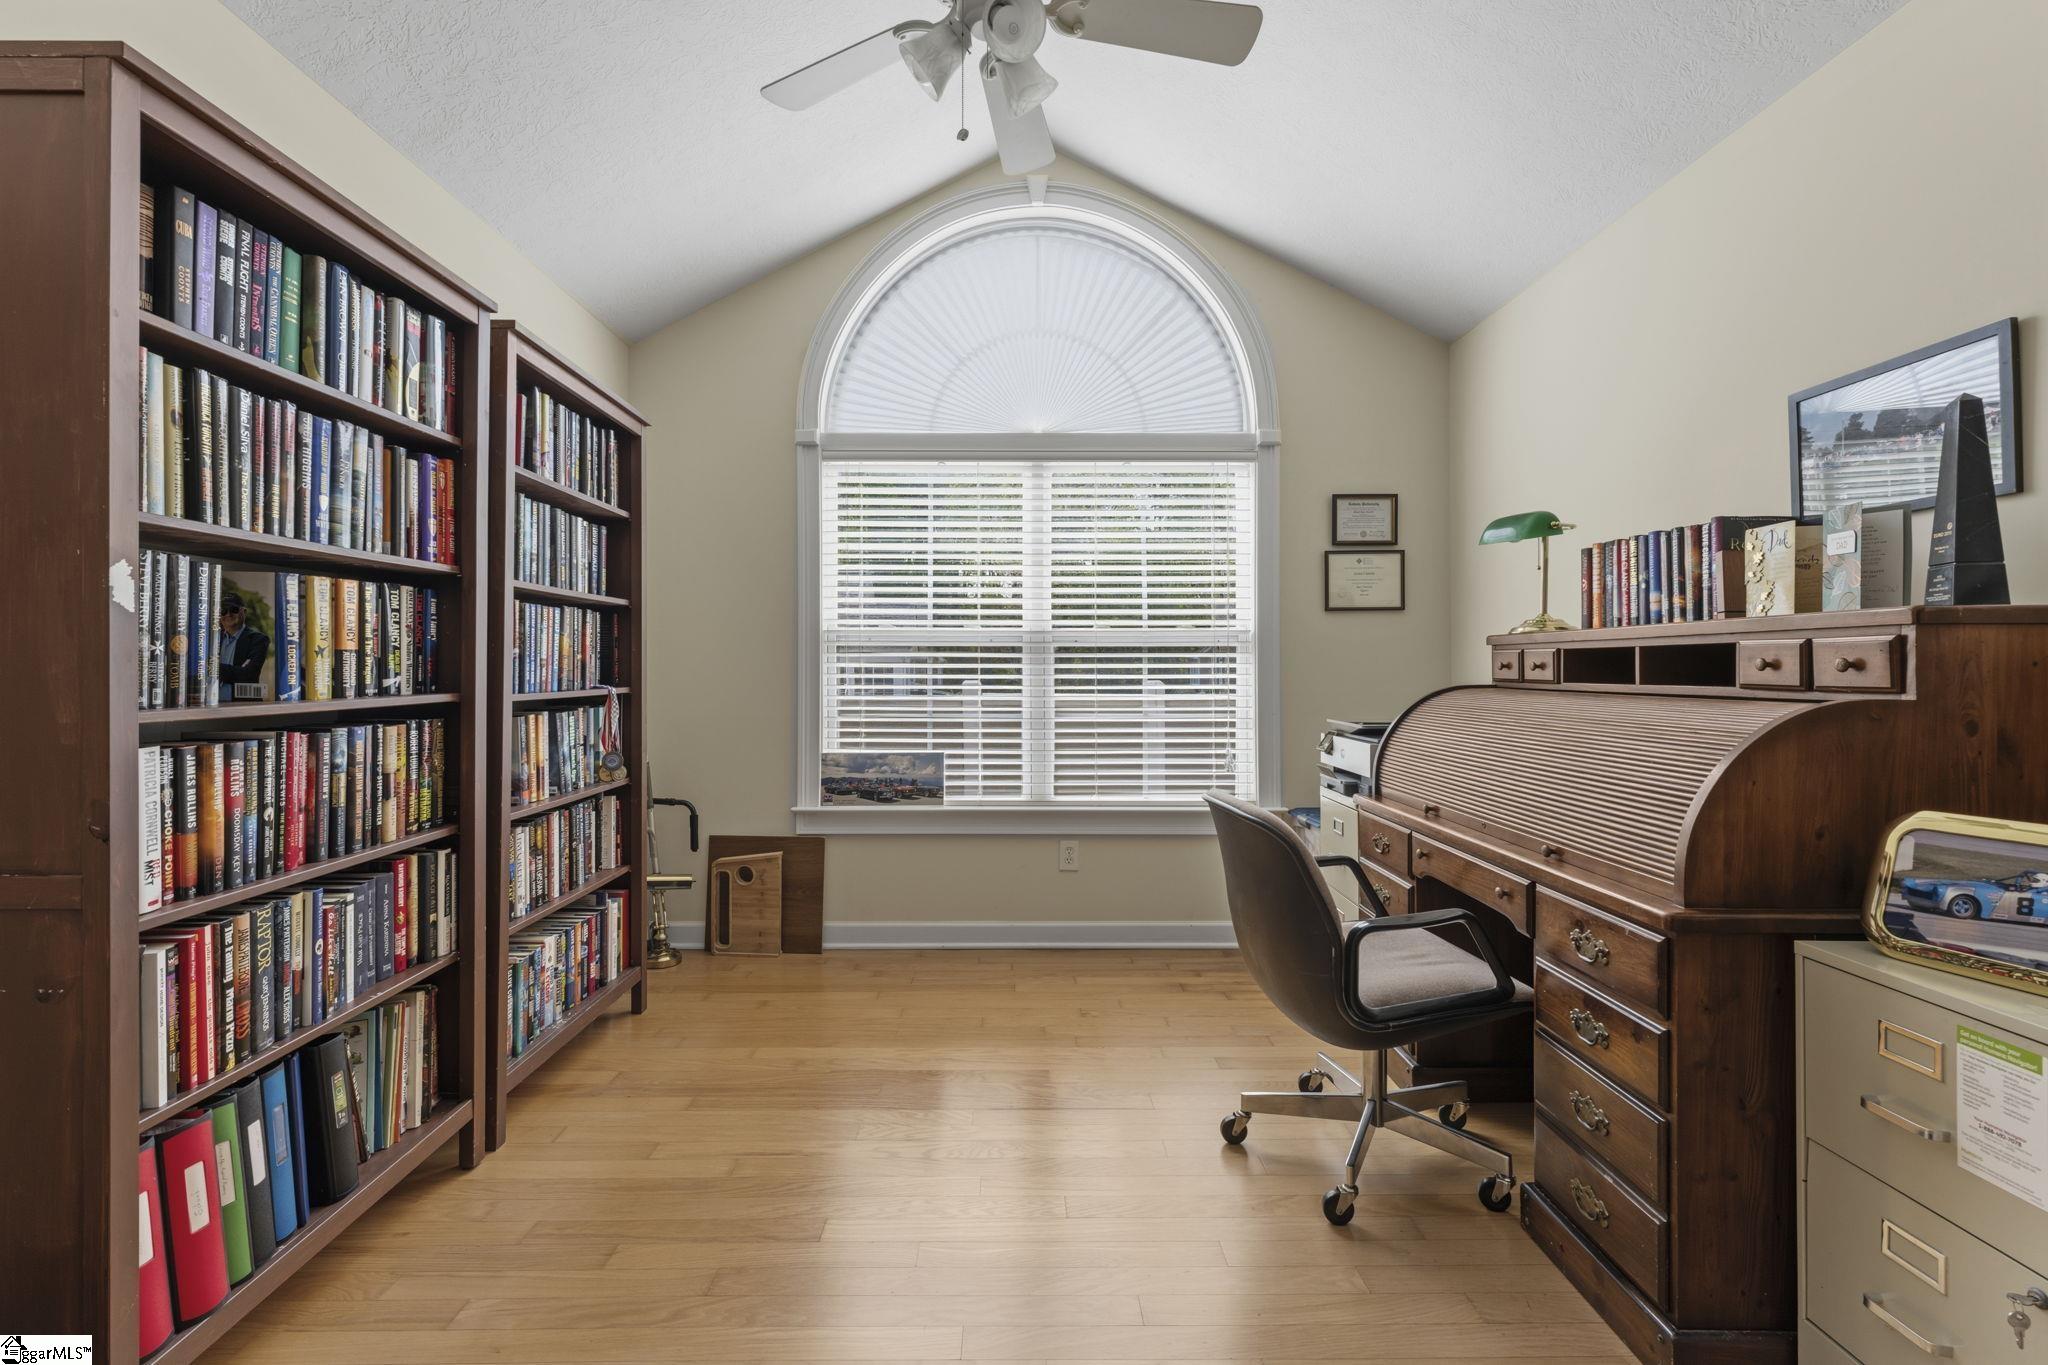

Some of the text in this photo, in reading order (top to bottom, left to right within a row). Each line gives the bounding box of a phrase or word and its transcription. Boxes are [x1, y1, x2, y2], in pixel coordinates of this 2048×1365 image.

[175, 219, 192, 239] CUBA
[219, 219, 228, 244] SIEGE
[241, 229, 250, 256] FINAL
[239, 258, 249, 293] FLIGHT
[267, 287, 279, 354] CANNIBAL QUEEN
[338, 269, 347, 341] DAN BROWN
[240, 392, 249, 426] Daniel
[240, 428, 249, 453] Silva
[301, 416, 311, 489] JACK HIGGINS
[139, 553, 149, 630] STEVE BERRY
[177, 560, 187, 632] STEVE BERRY
[153, 598, 161, 635] EXCHANGE
[197, 566, 208, 680] Daniel Silva Moscow Rules
[319, 606, 328, 642] CLANCY
[346, 584, 355, 642] TOM CLANCY
[364, 602, 372, 620] Bear
[390, 589, 399, 647] TOM CLANCY
[427, 615, 437, 640] Clancy
[170, 661, 179, 688] TOMB
[287, 644, 296, 672] LOCKED
[342, 651, 350, 688] AUTHORITY
[363, 656, 372, 684] Dragon
[287, 674, 296, 684] ON
[186, 754, 196, 786] JAMES
[409, 730, 418, 779] ROBERT LUDLUM
[213, 747, 223, 810] JAMES ROLLINS
[230, 758, 239, 797] ROLLINS
[144, 750, 158, 855] PATRICIA CORNWELL
[186, 788, 196, 828] ROLLINS
[152, 858, 160, 877] RED
[164, 809, 172, 889] CHOKE POINT
[143, 859, 153, 885] MIST
[327, 912, 334, 923] Go
[256, 908, 271, 974] RAPTOR
[222, 926, 235, 1053] The Family Mario Puzo
[235, 1000, 250, 1039] CROSS
[260, 993, 269, 1031] JENNINGS
[282, 1002, 290, 1024] CROSS
